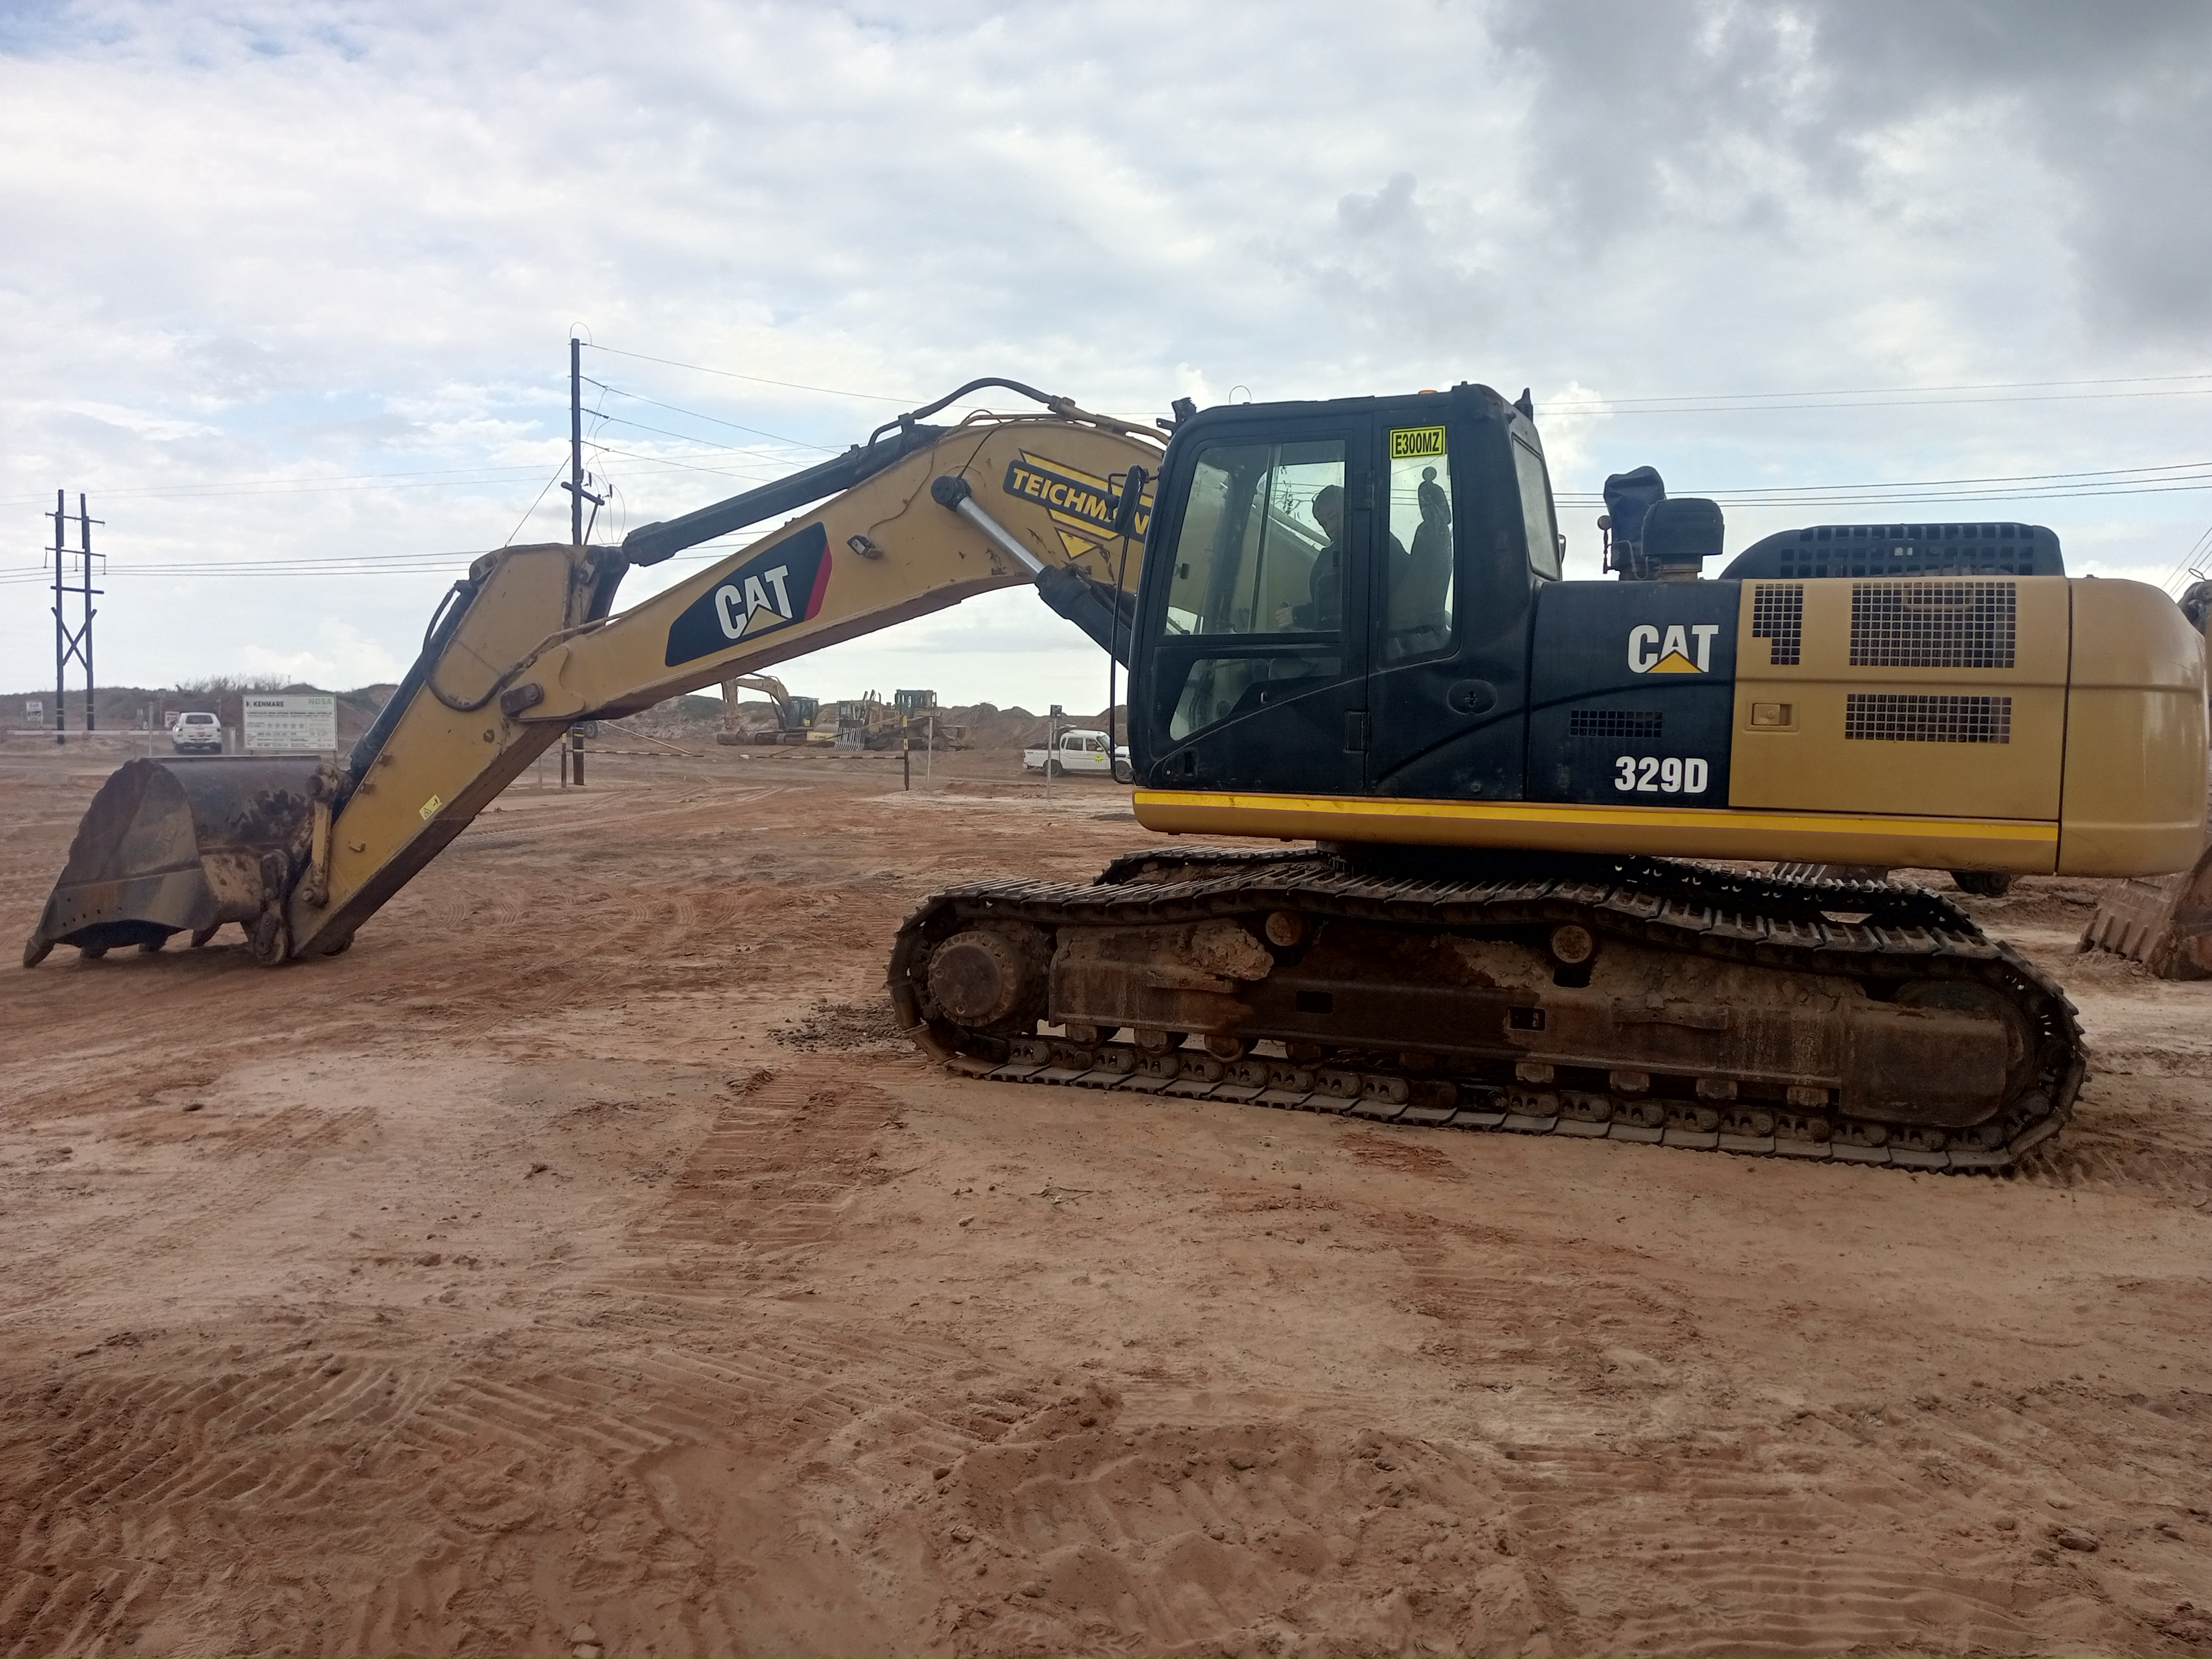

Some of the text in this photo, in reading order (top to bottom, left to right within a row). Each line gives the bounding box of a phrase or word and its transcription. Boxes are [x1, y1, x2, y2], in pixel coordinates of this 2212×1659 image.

[1395, 432, 1440, 455] E300MZ
[1012, 467, 1150, 535] TEICHMN
[715, 564, 794, 640] CAT
[1627, 624, 1719, 674] CAT
[1614, 755, 1709, 794] 329D
